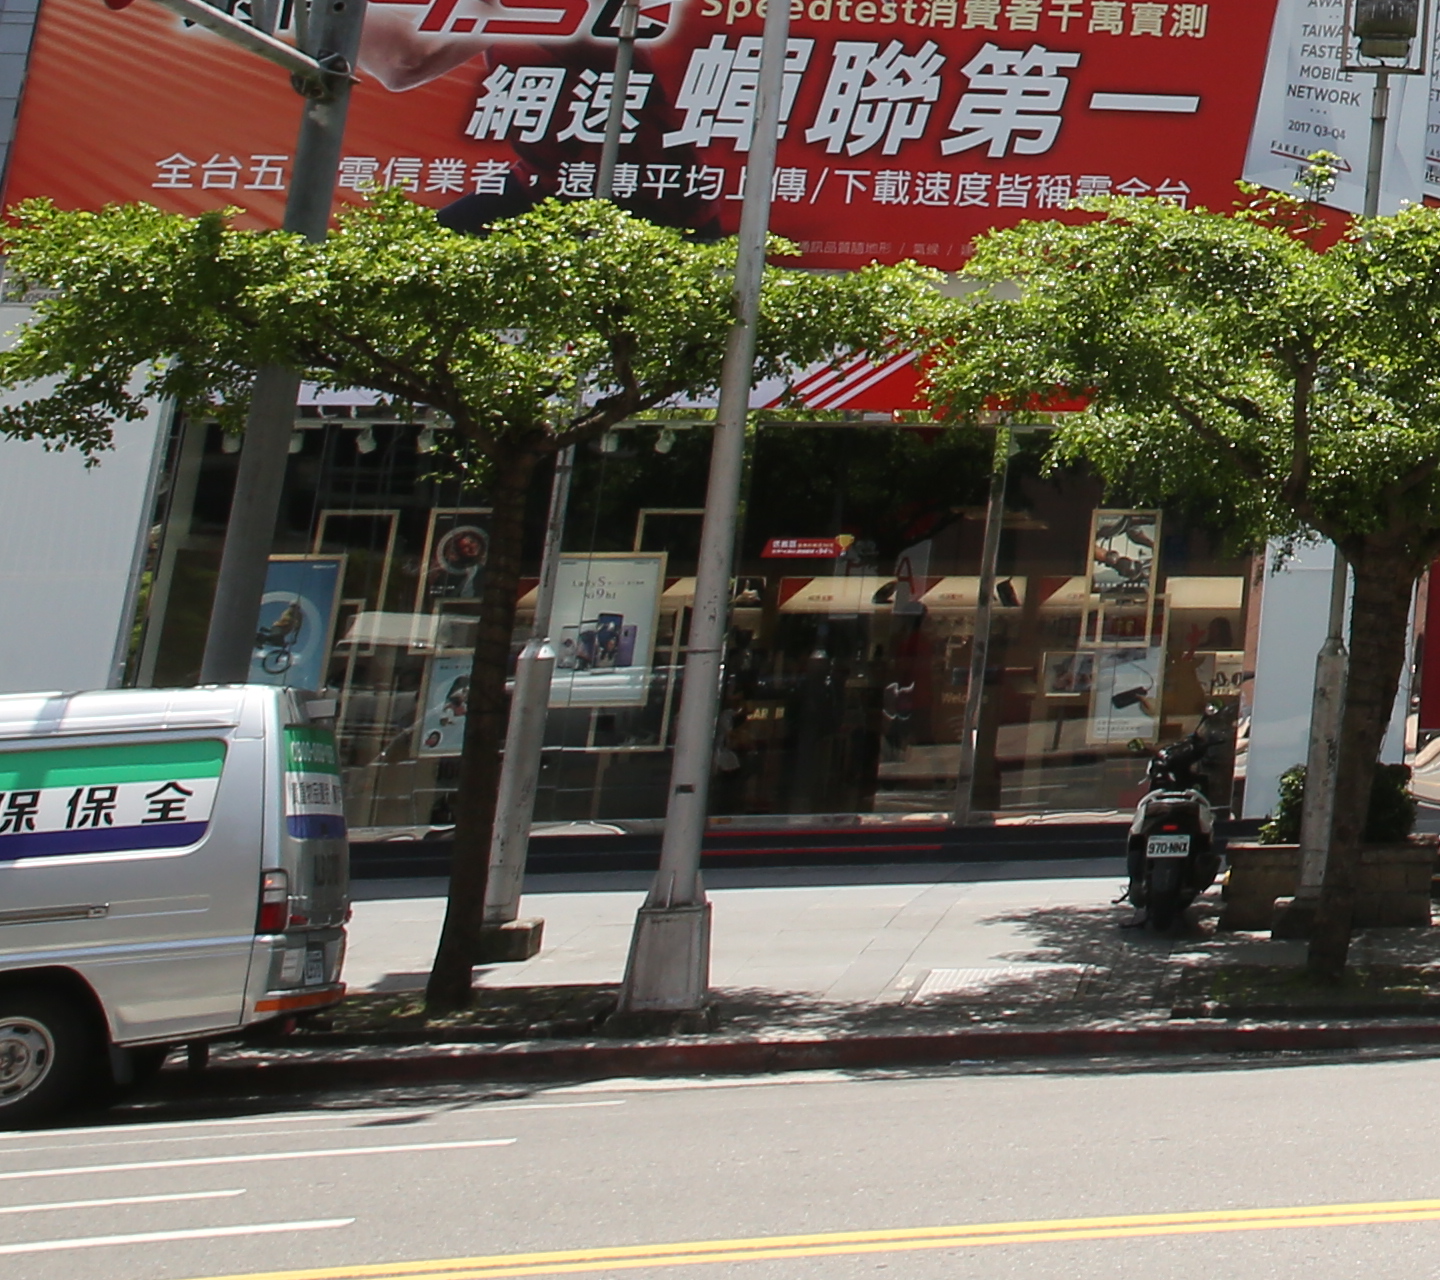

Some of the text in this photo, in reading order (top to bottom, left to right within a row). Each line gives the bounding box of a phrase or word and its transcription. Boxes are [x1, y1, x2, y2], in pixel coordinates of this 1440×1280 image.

[1286, 84, 1362, 107] NETWORK
[1288, 120, 1346, 140] 2017 Q3-Q4
